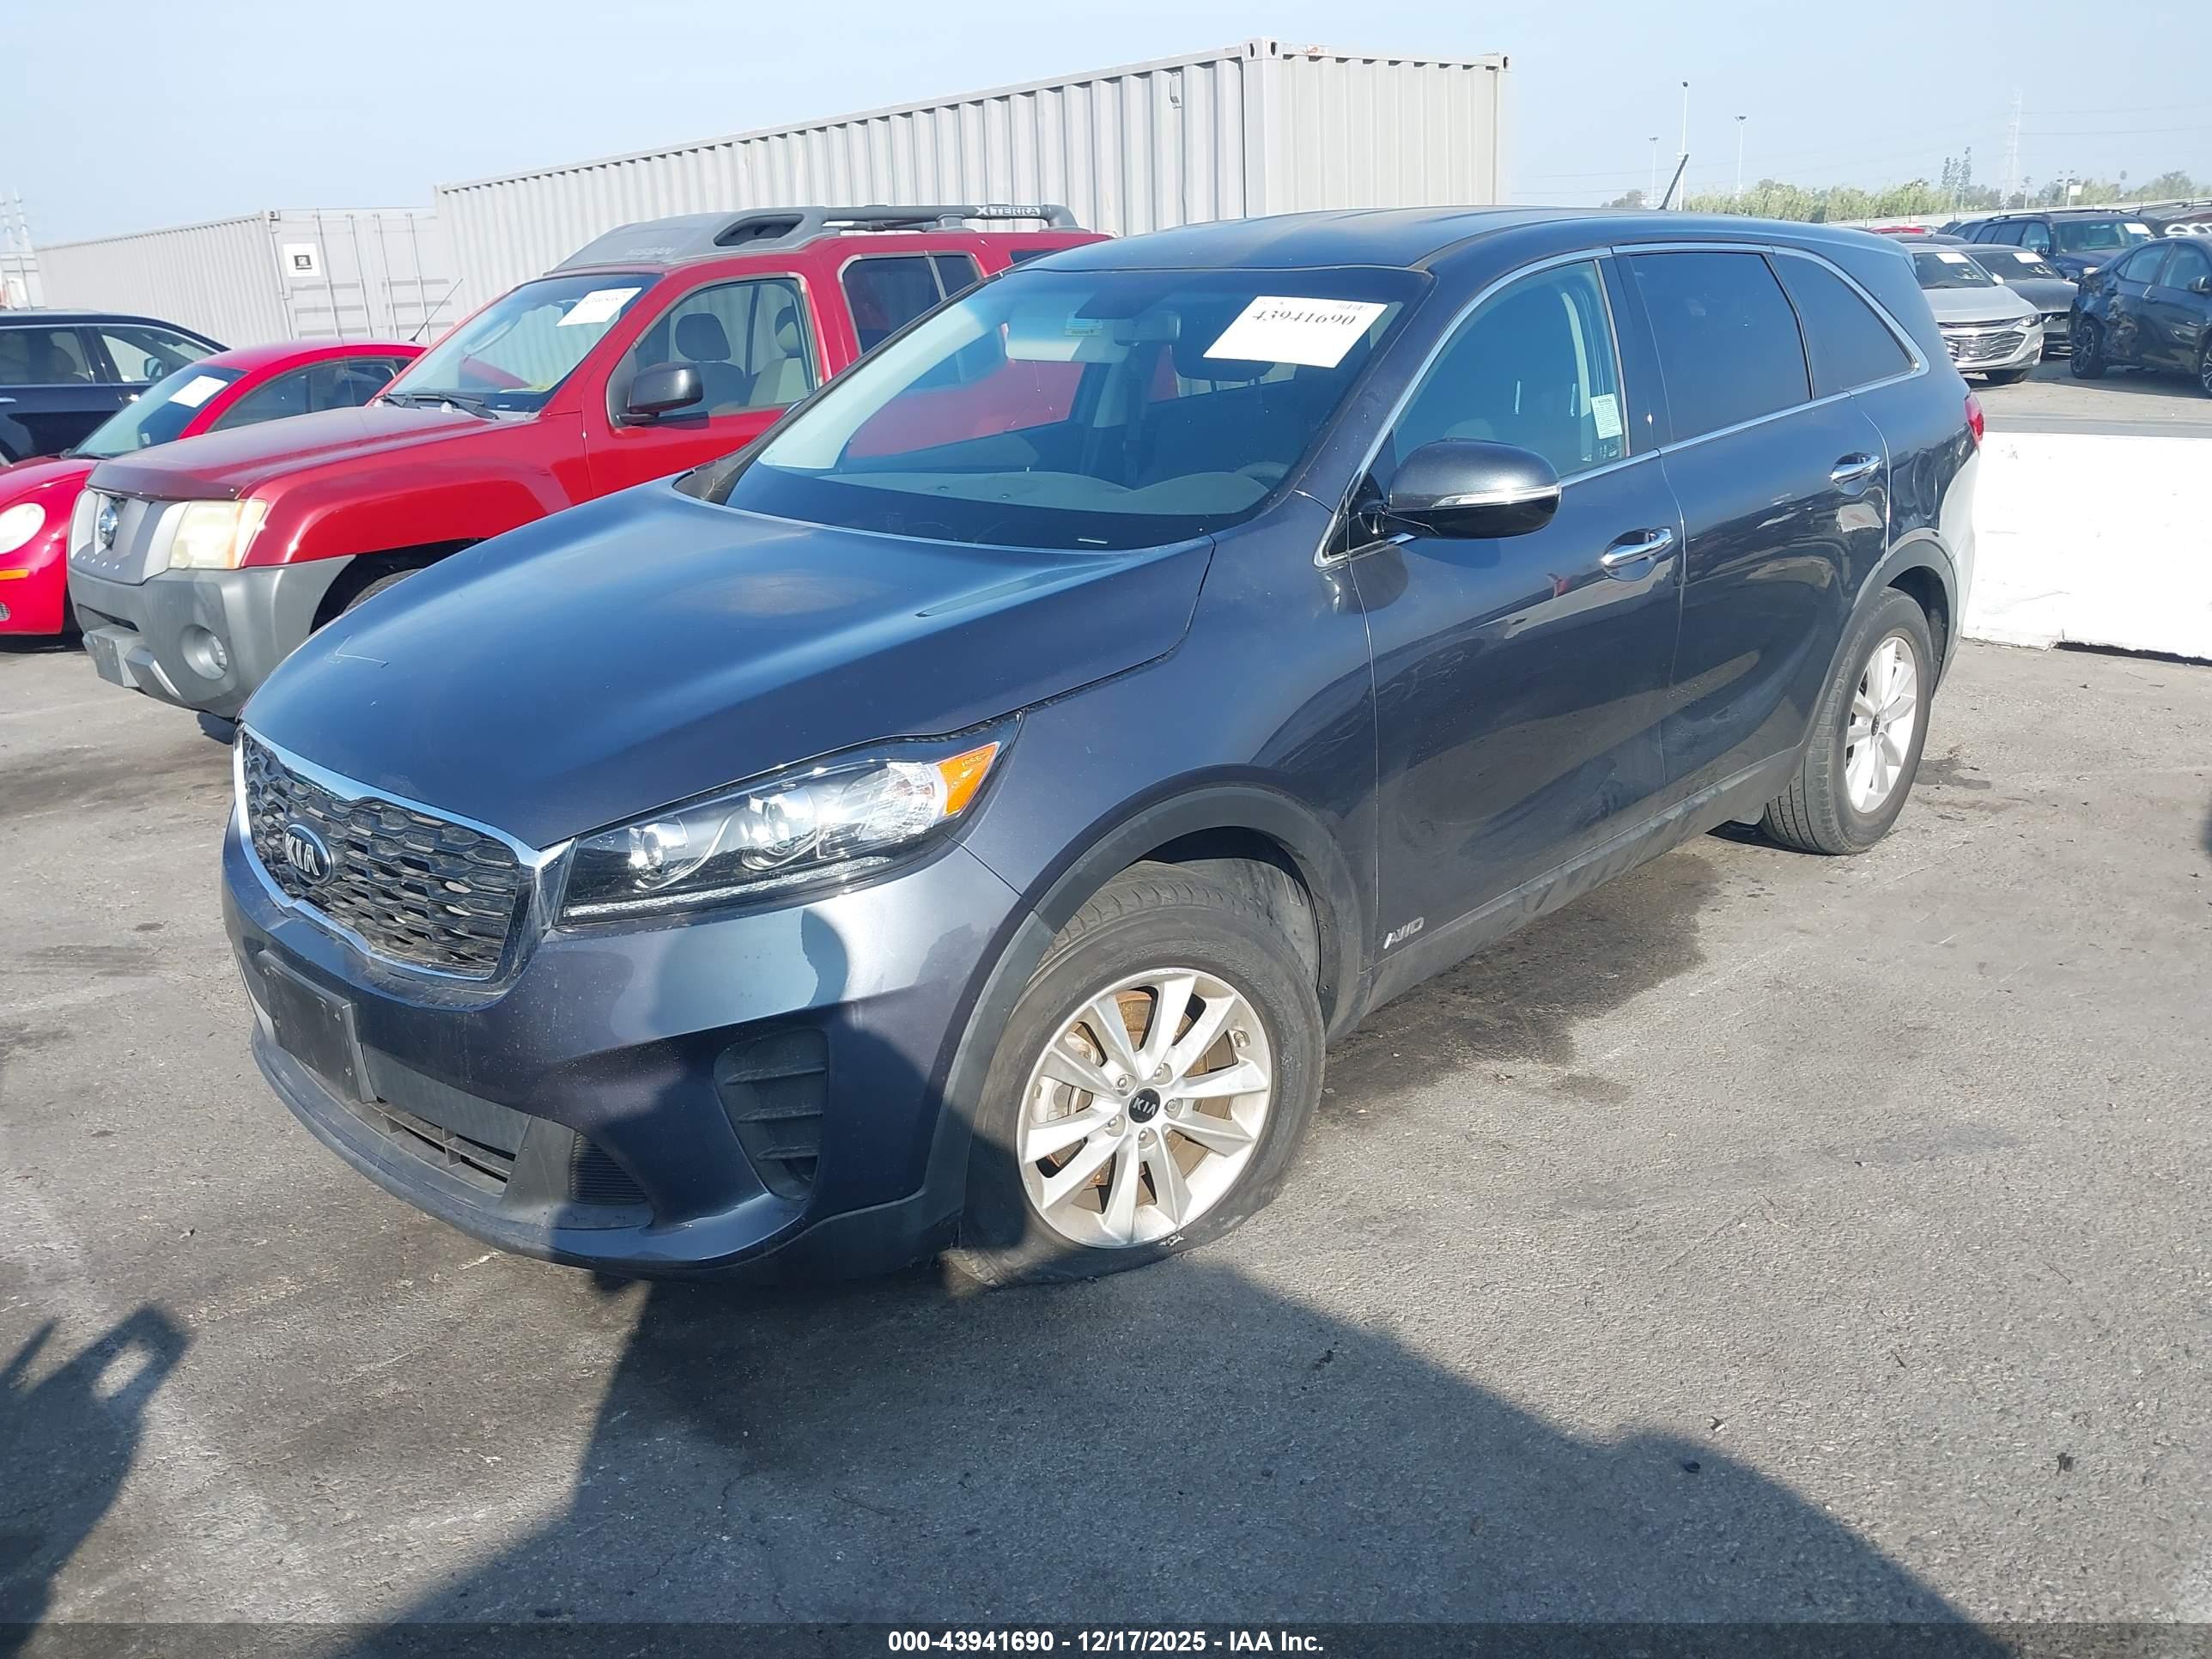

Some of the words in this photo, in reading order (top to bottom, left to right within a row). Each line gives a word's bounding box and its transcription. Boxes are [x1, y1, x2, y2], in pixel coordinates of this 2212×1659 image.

[975, 206, 1041, 216] XTERRA
[1252, 310, 1357, 325] 43941690
[285, 833, 320, 876] KIA
[1382, 917, 1425, 950] AWD
[1133, 1097, 1157, 1115] KIA
